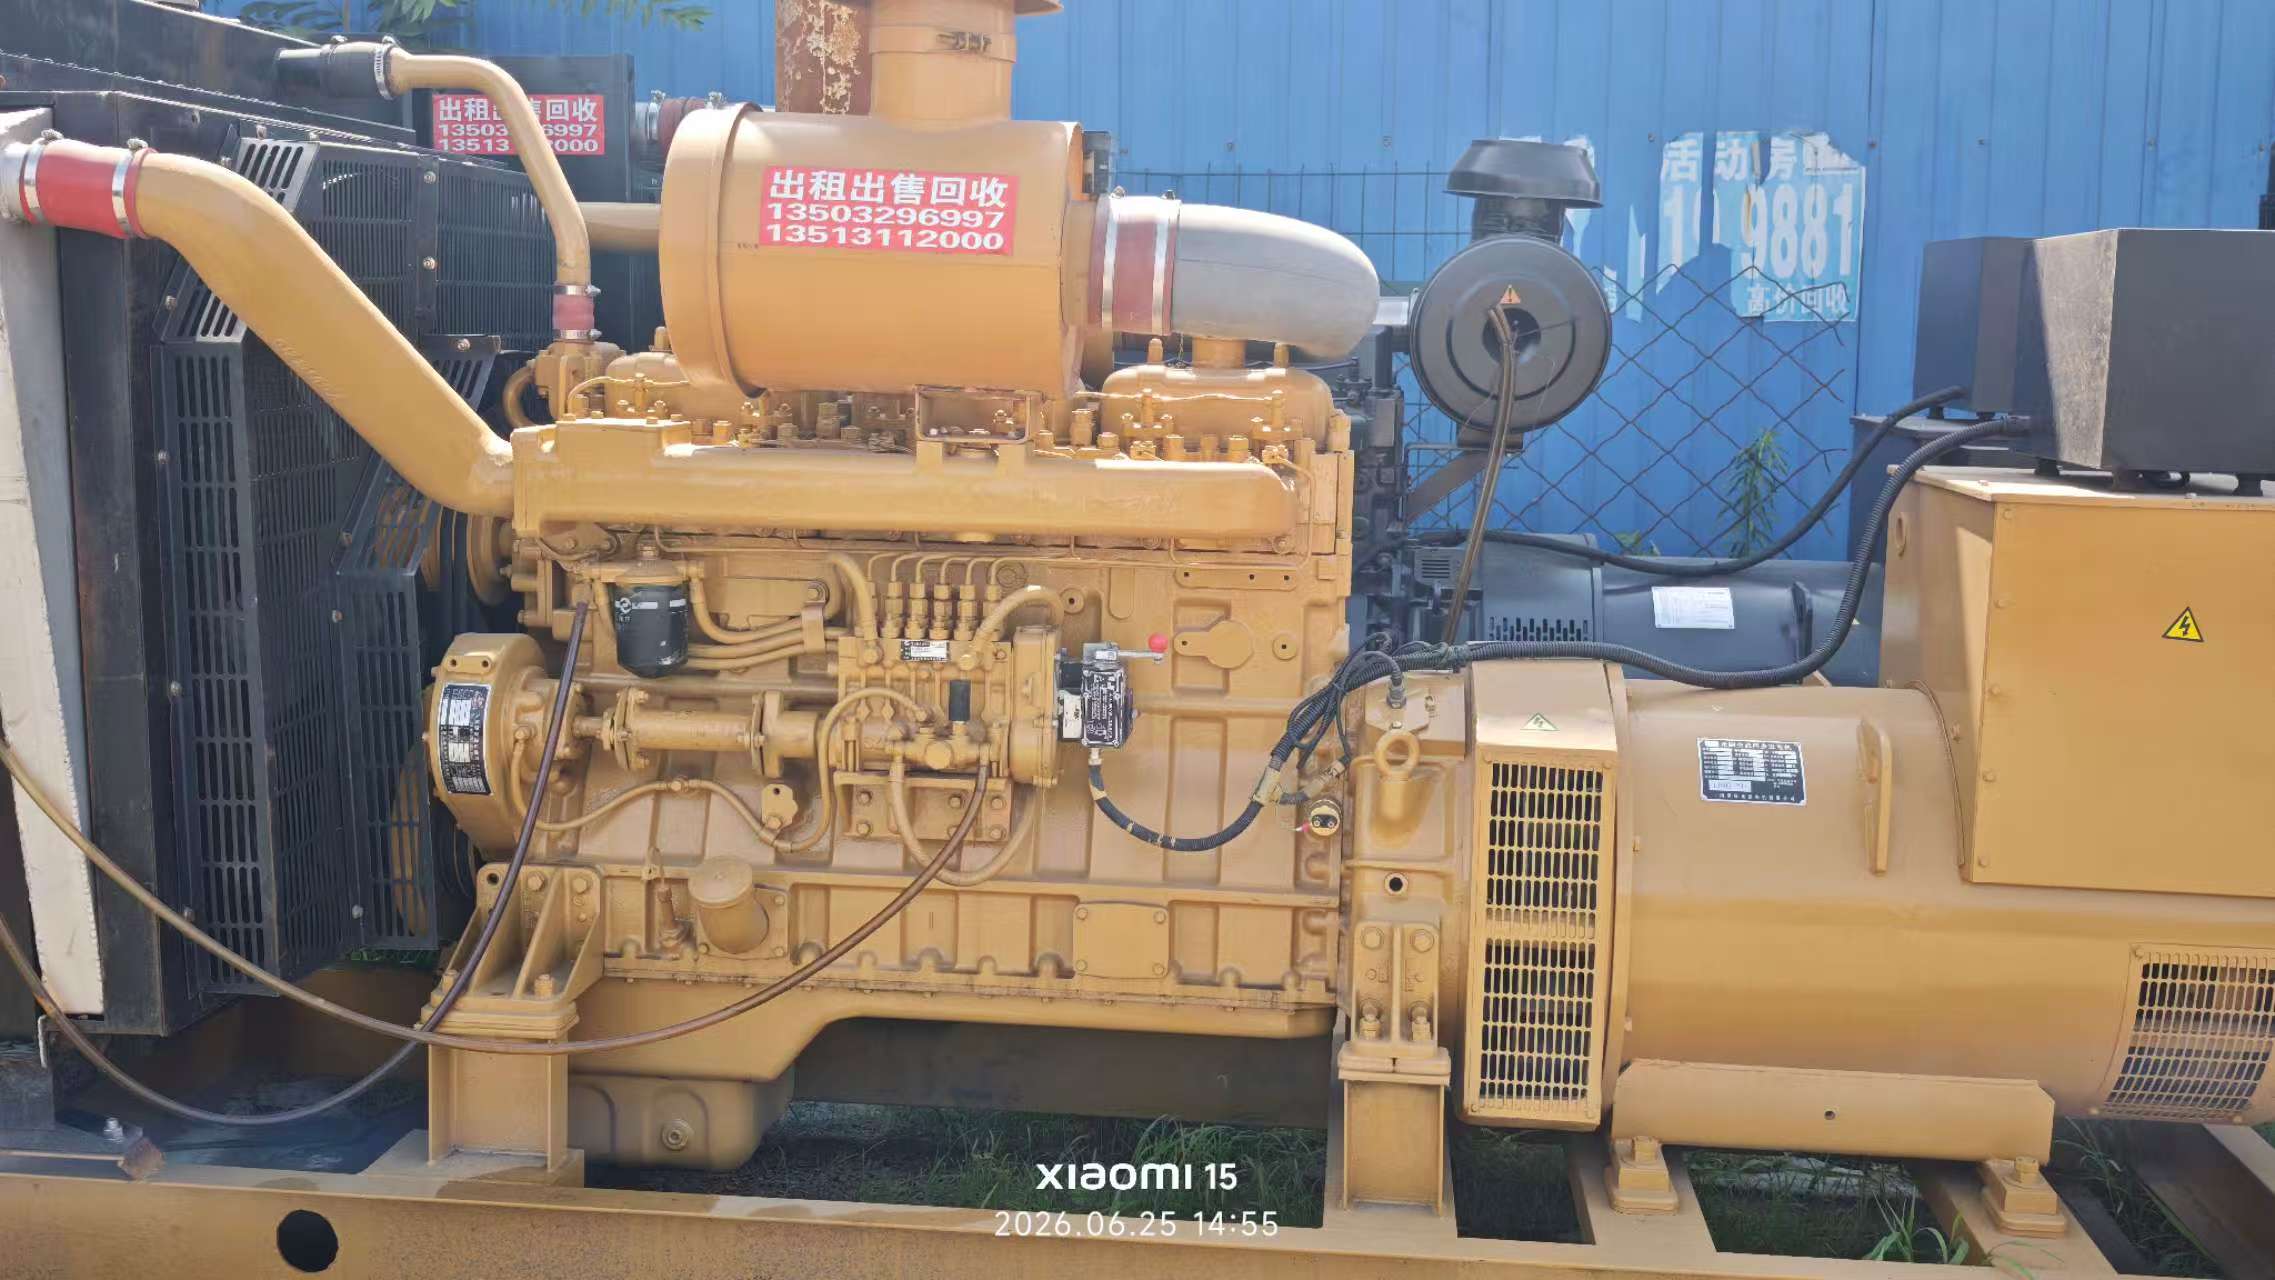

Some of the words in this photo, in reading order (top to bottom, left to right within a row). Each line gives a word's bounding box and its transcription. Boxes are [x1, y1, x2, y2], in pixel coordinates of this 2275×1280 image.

[438, 96, 597, 122] 出租回收
[438, 123, 597, 137] 135036997
[438, 138, 599, 152] 13513000
[769, 169, 1009, 208] 出租出售回收
[767, 203, 1005, 229] 13503296997
[766, 223, 1005, 250] 13513112000
